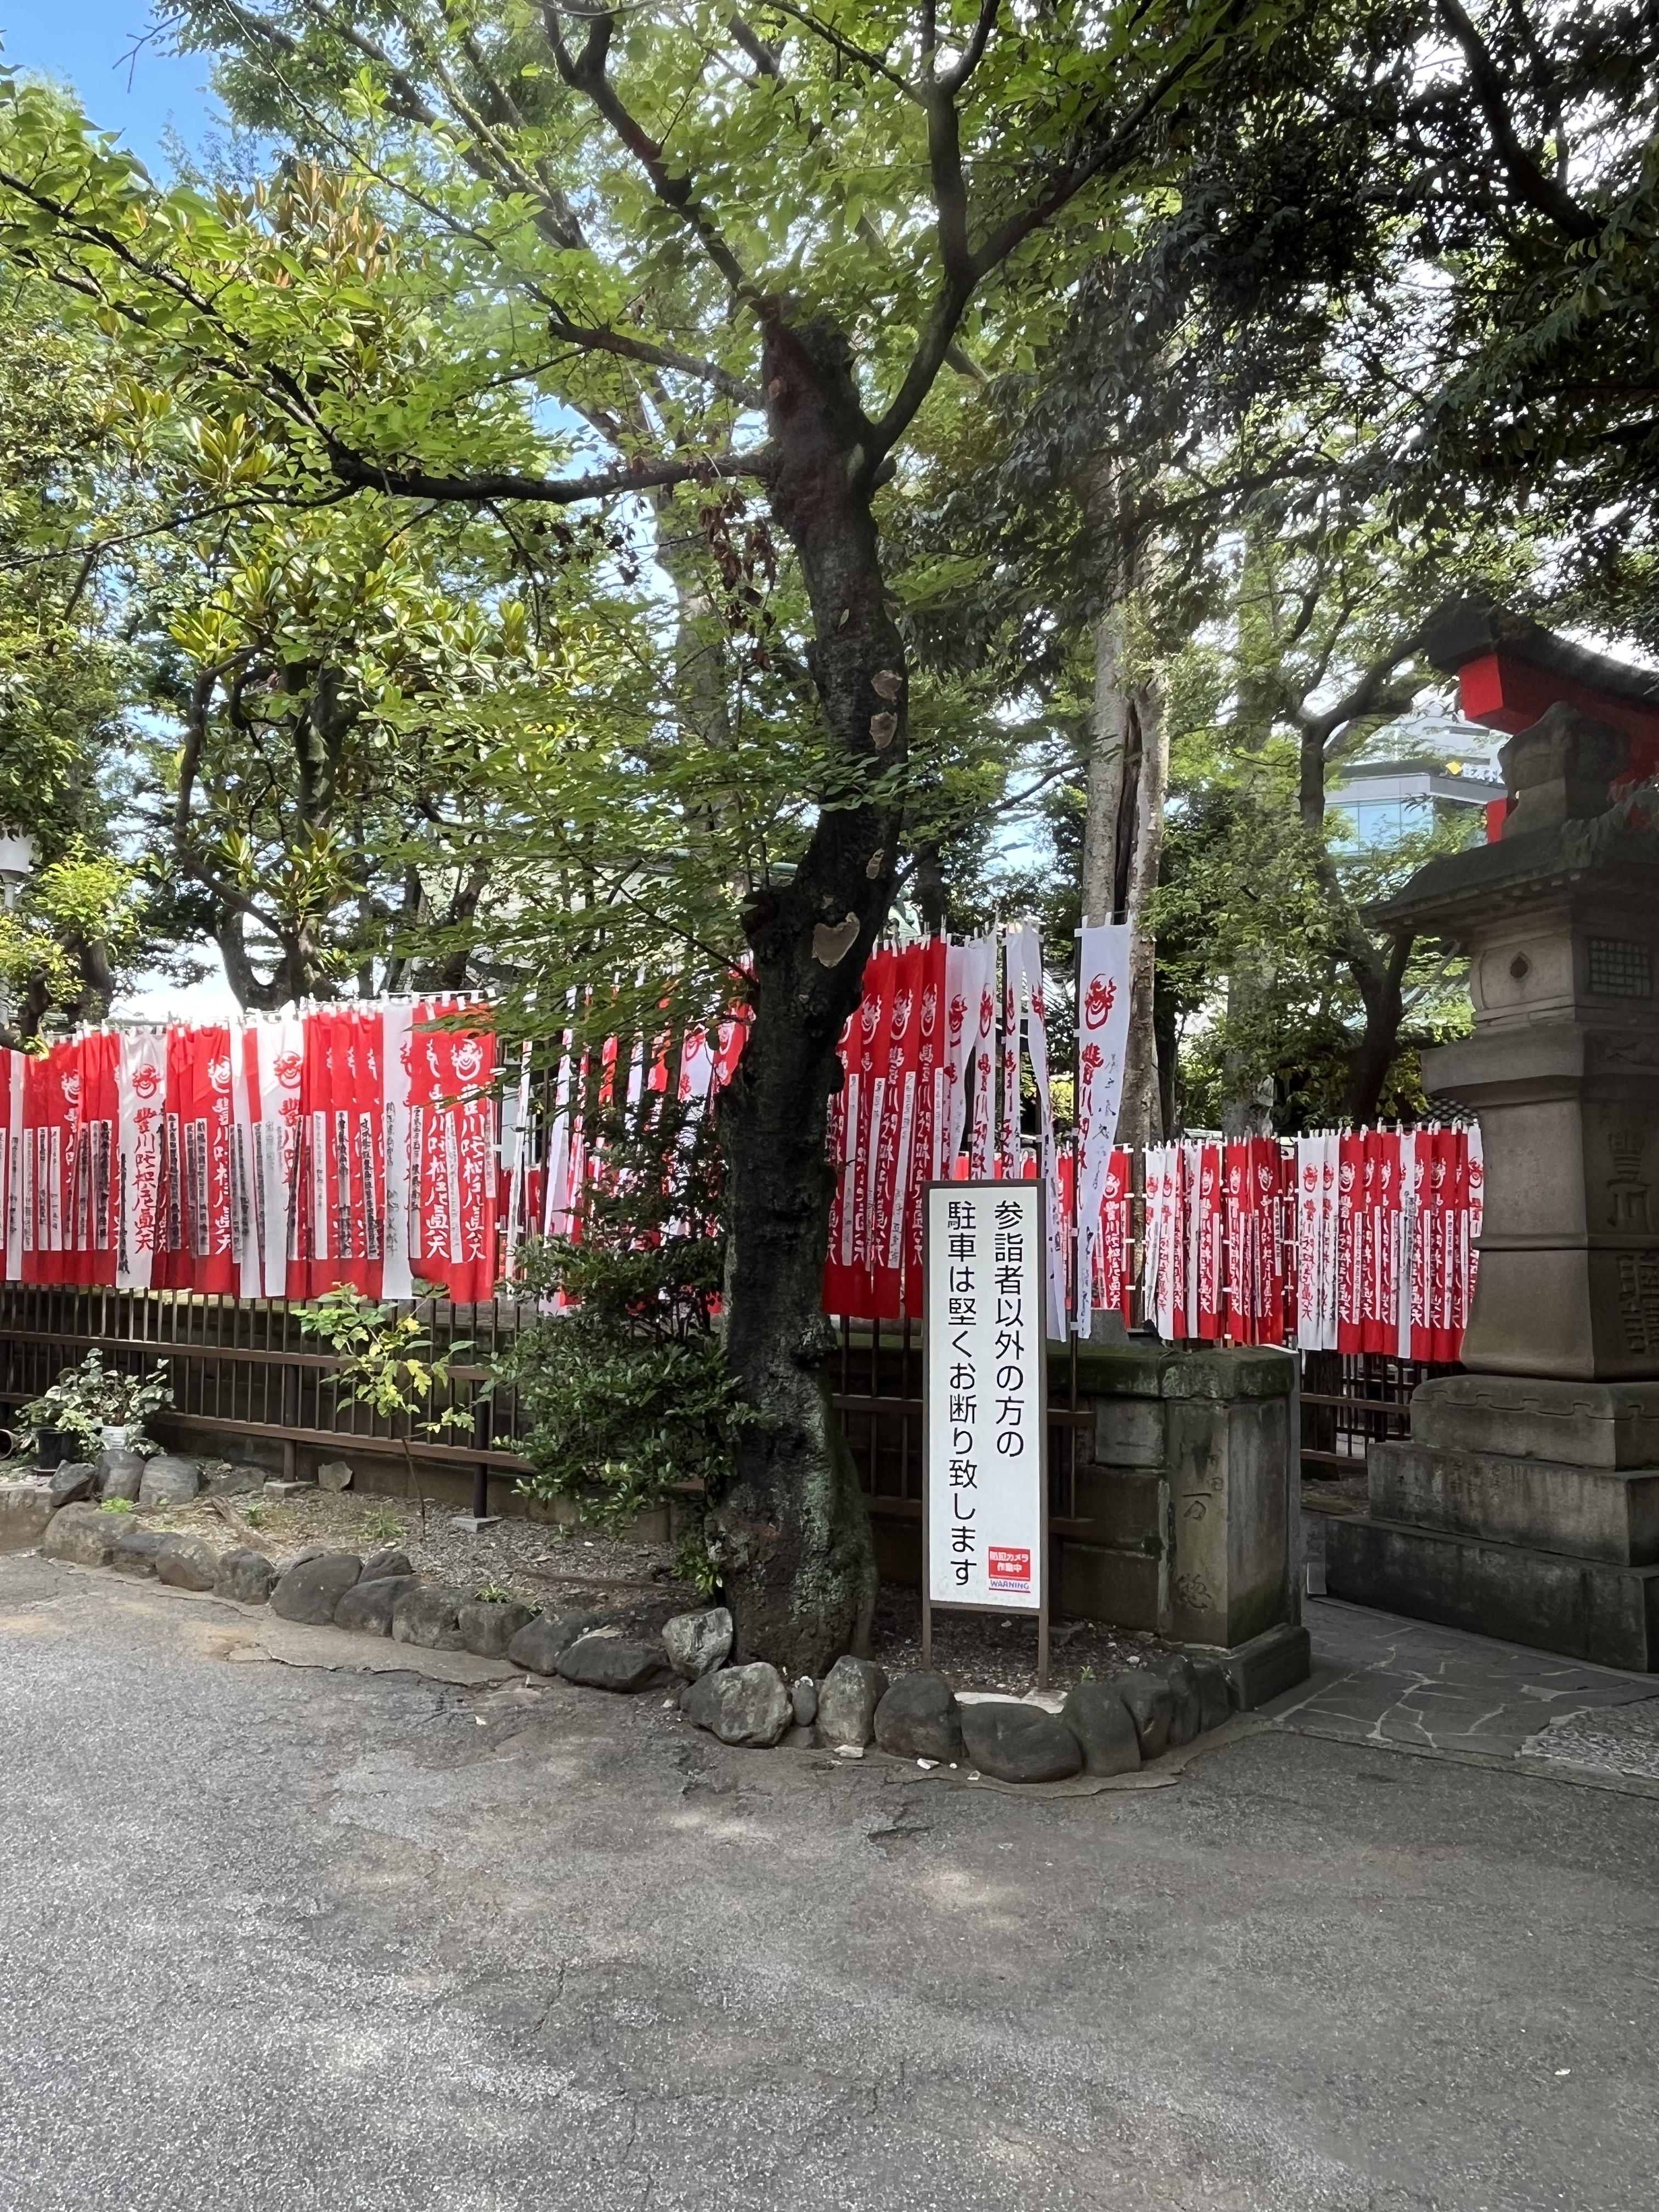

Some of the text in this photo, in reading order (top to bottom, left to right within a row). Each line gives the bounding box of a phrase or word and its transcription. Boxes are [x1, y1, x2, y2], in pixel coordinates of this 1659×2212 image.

[947, 1200, 978, 1586] 駐車は堅くお断り致します
[994, 1200, 1025, 1457] 参詣者以外の方の
[990, 1579, 1029, 1589] WARNING
